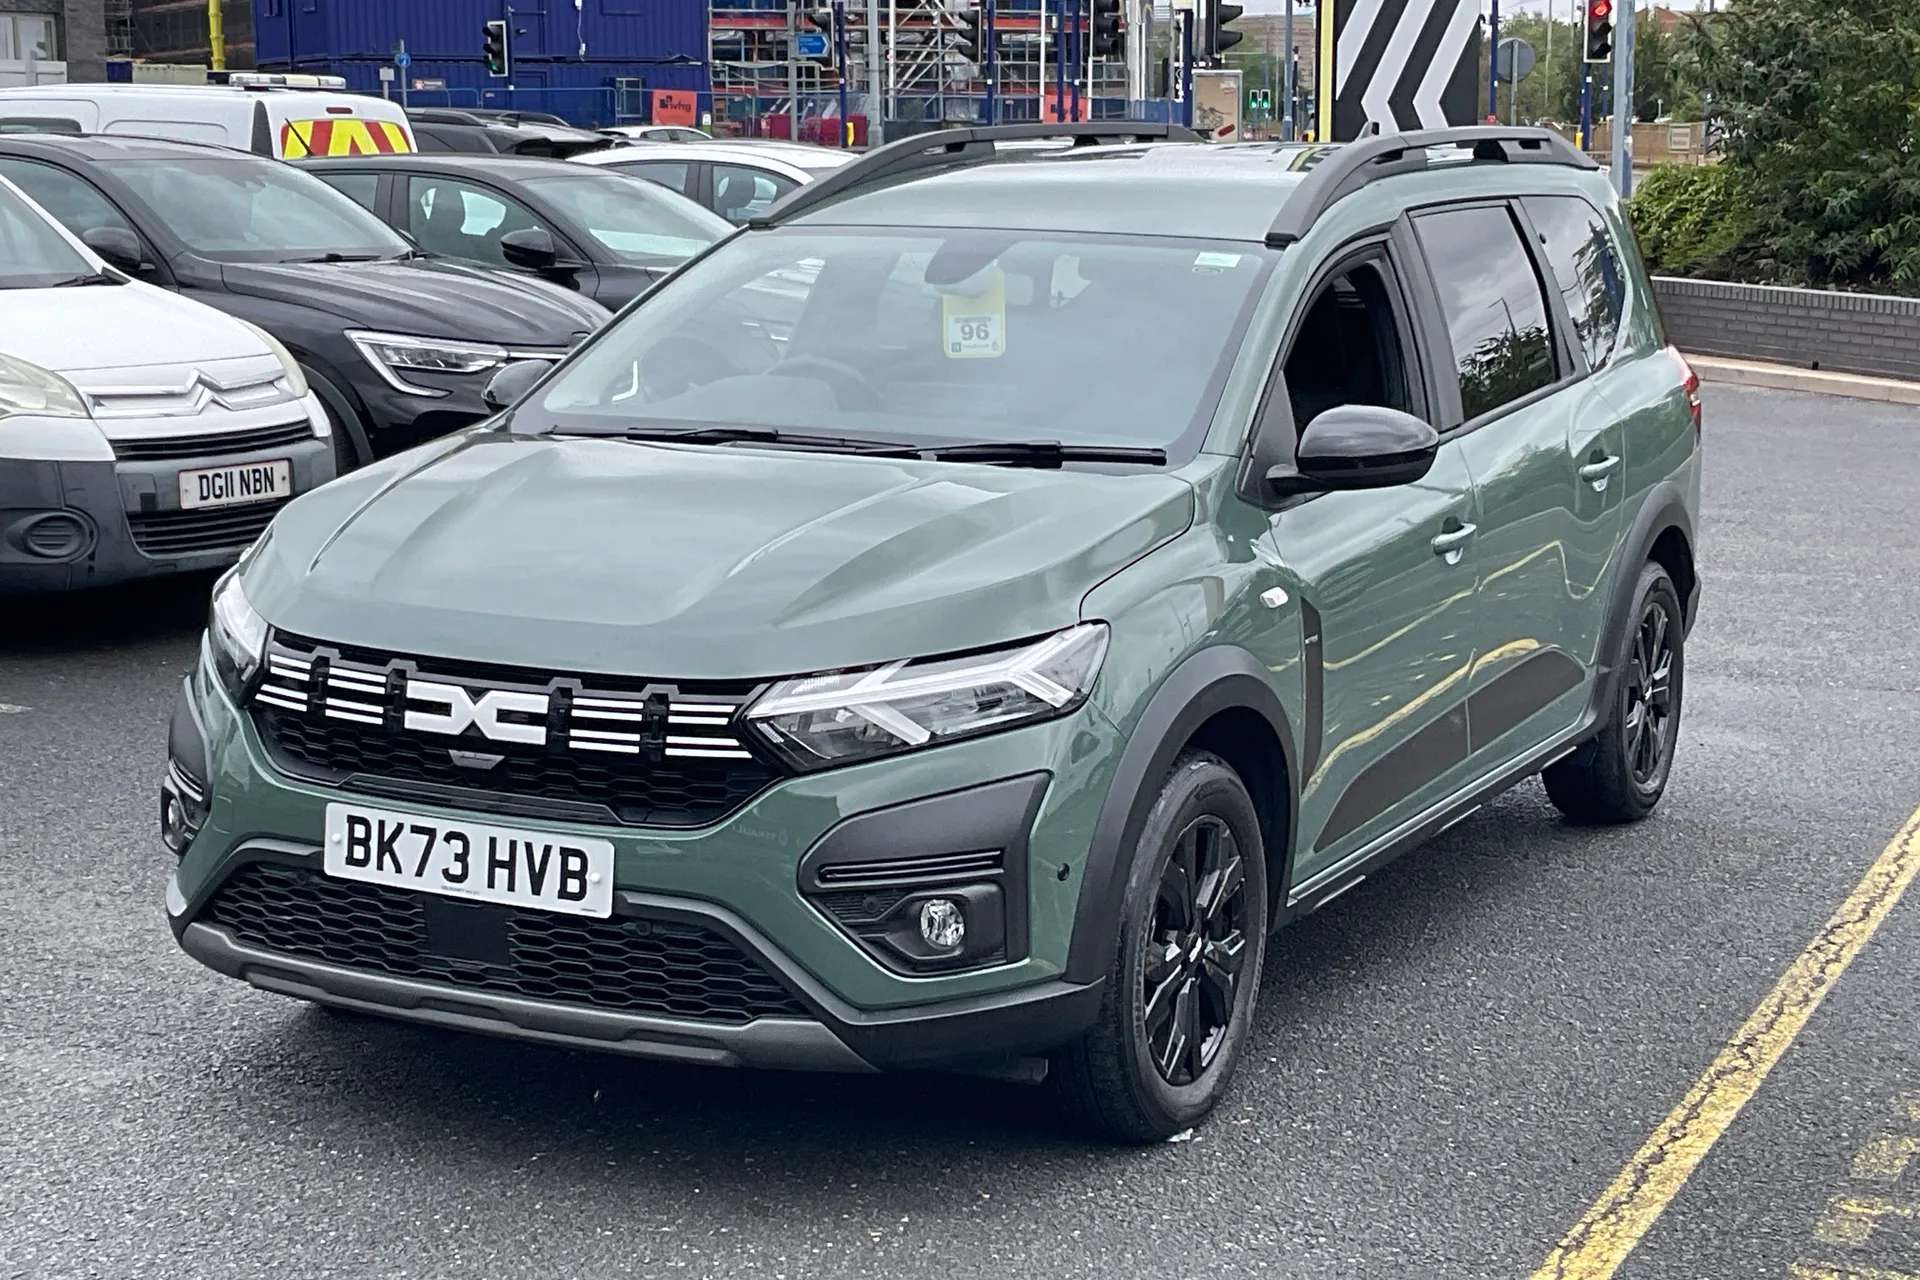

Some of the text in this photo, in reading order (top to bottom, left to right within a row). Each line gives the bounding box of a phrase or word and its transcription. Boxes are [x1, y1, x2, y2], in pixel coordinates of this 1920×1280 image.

[961, 324, 990, 341] 96
[198, 466, 275, 501] DG11 NBN
[345, 813, 588, 902] BK73 HVB
